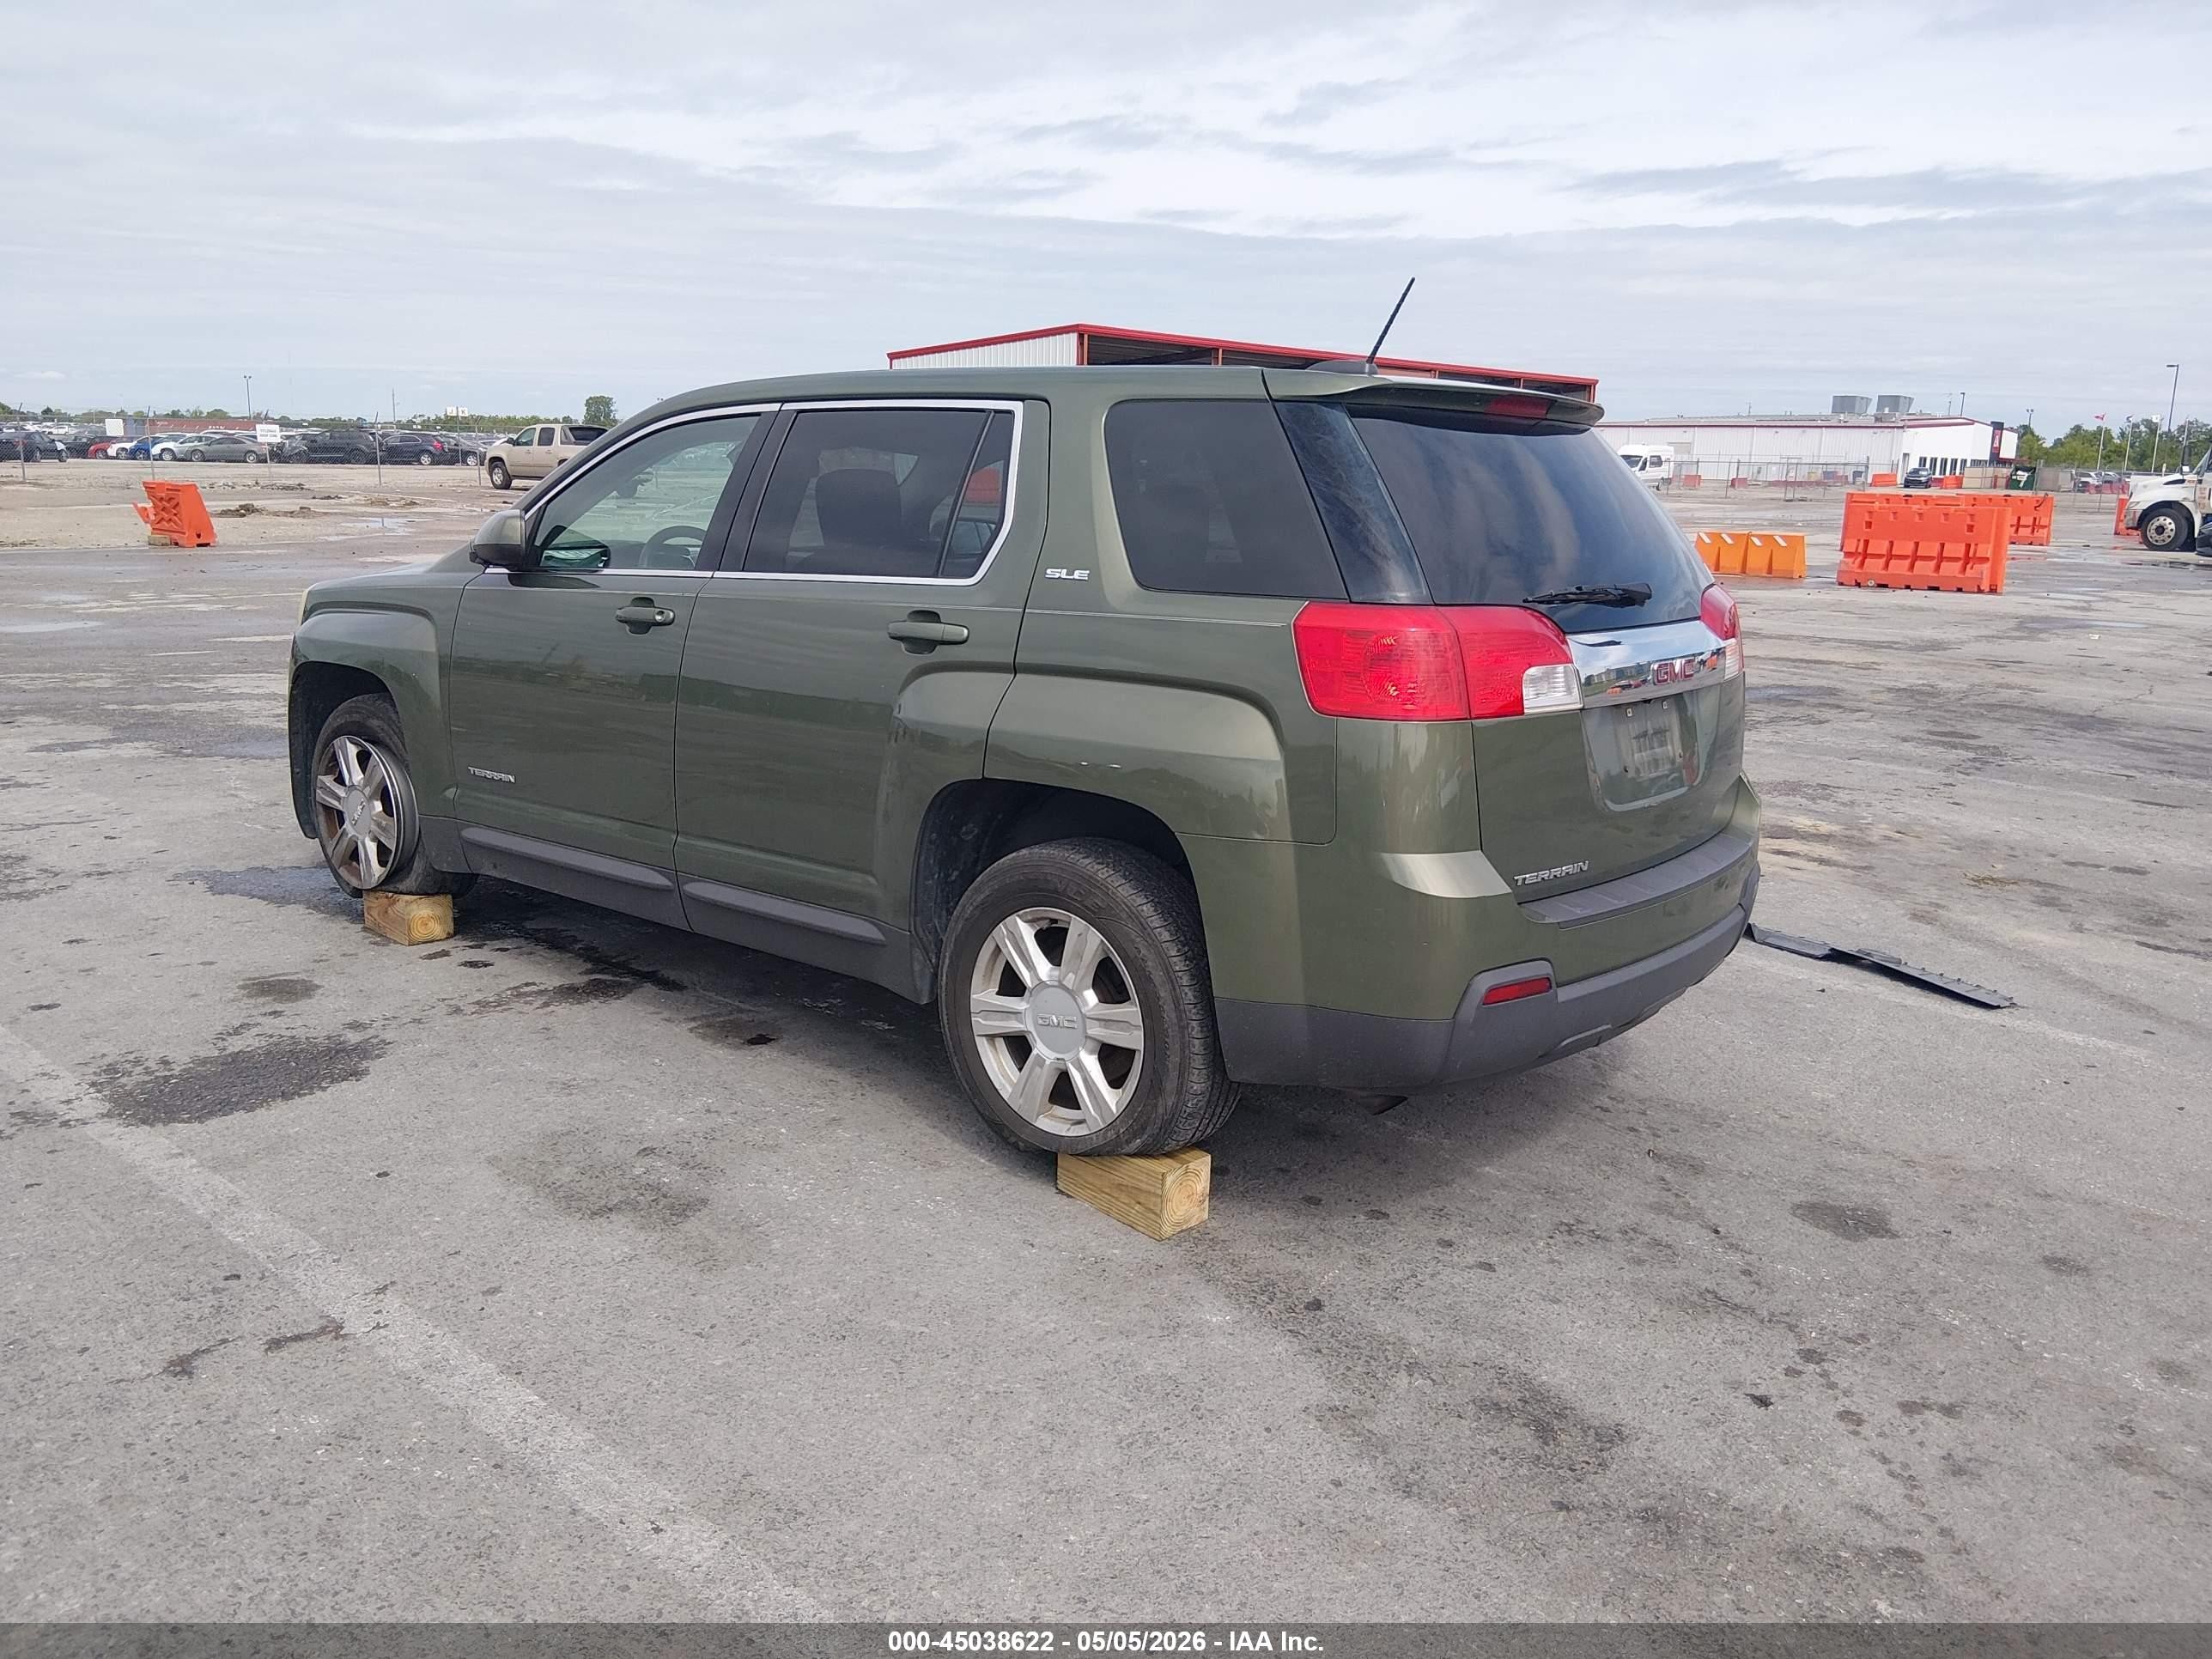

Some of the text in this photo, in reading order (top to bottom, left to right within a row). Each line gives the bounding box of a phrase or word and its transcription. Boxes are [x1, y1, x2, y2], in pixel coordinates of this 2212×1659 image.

[1045, 568, 1090, 580] SLE
[1654, 658, 1695, 684] GMC
[467, 766, 515, 783] TERRAIN
[1513, 860, 1589, 886] TERRAIN
[1037, 1014, 1078, 1030] GMC
